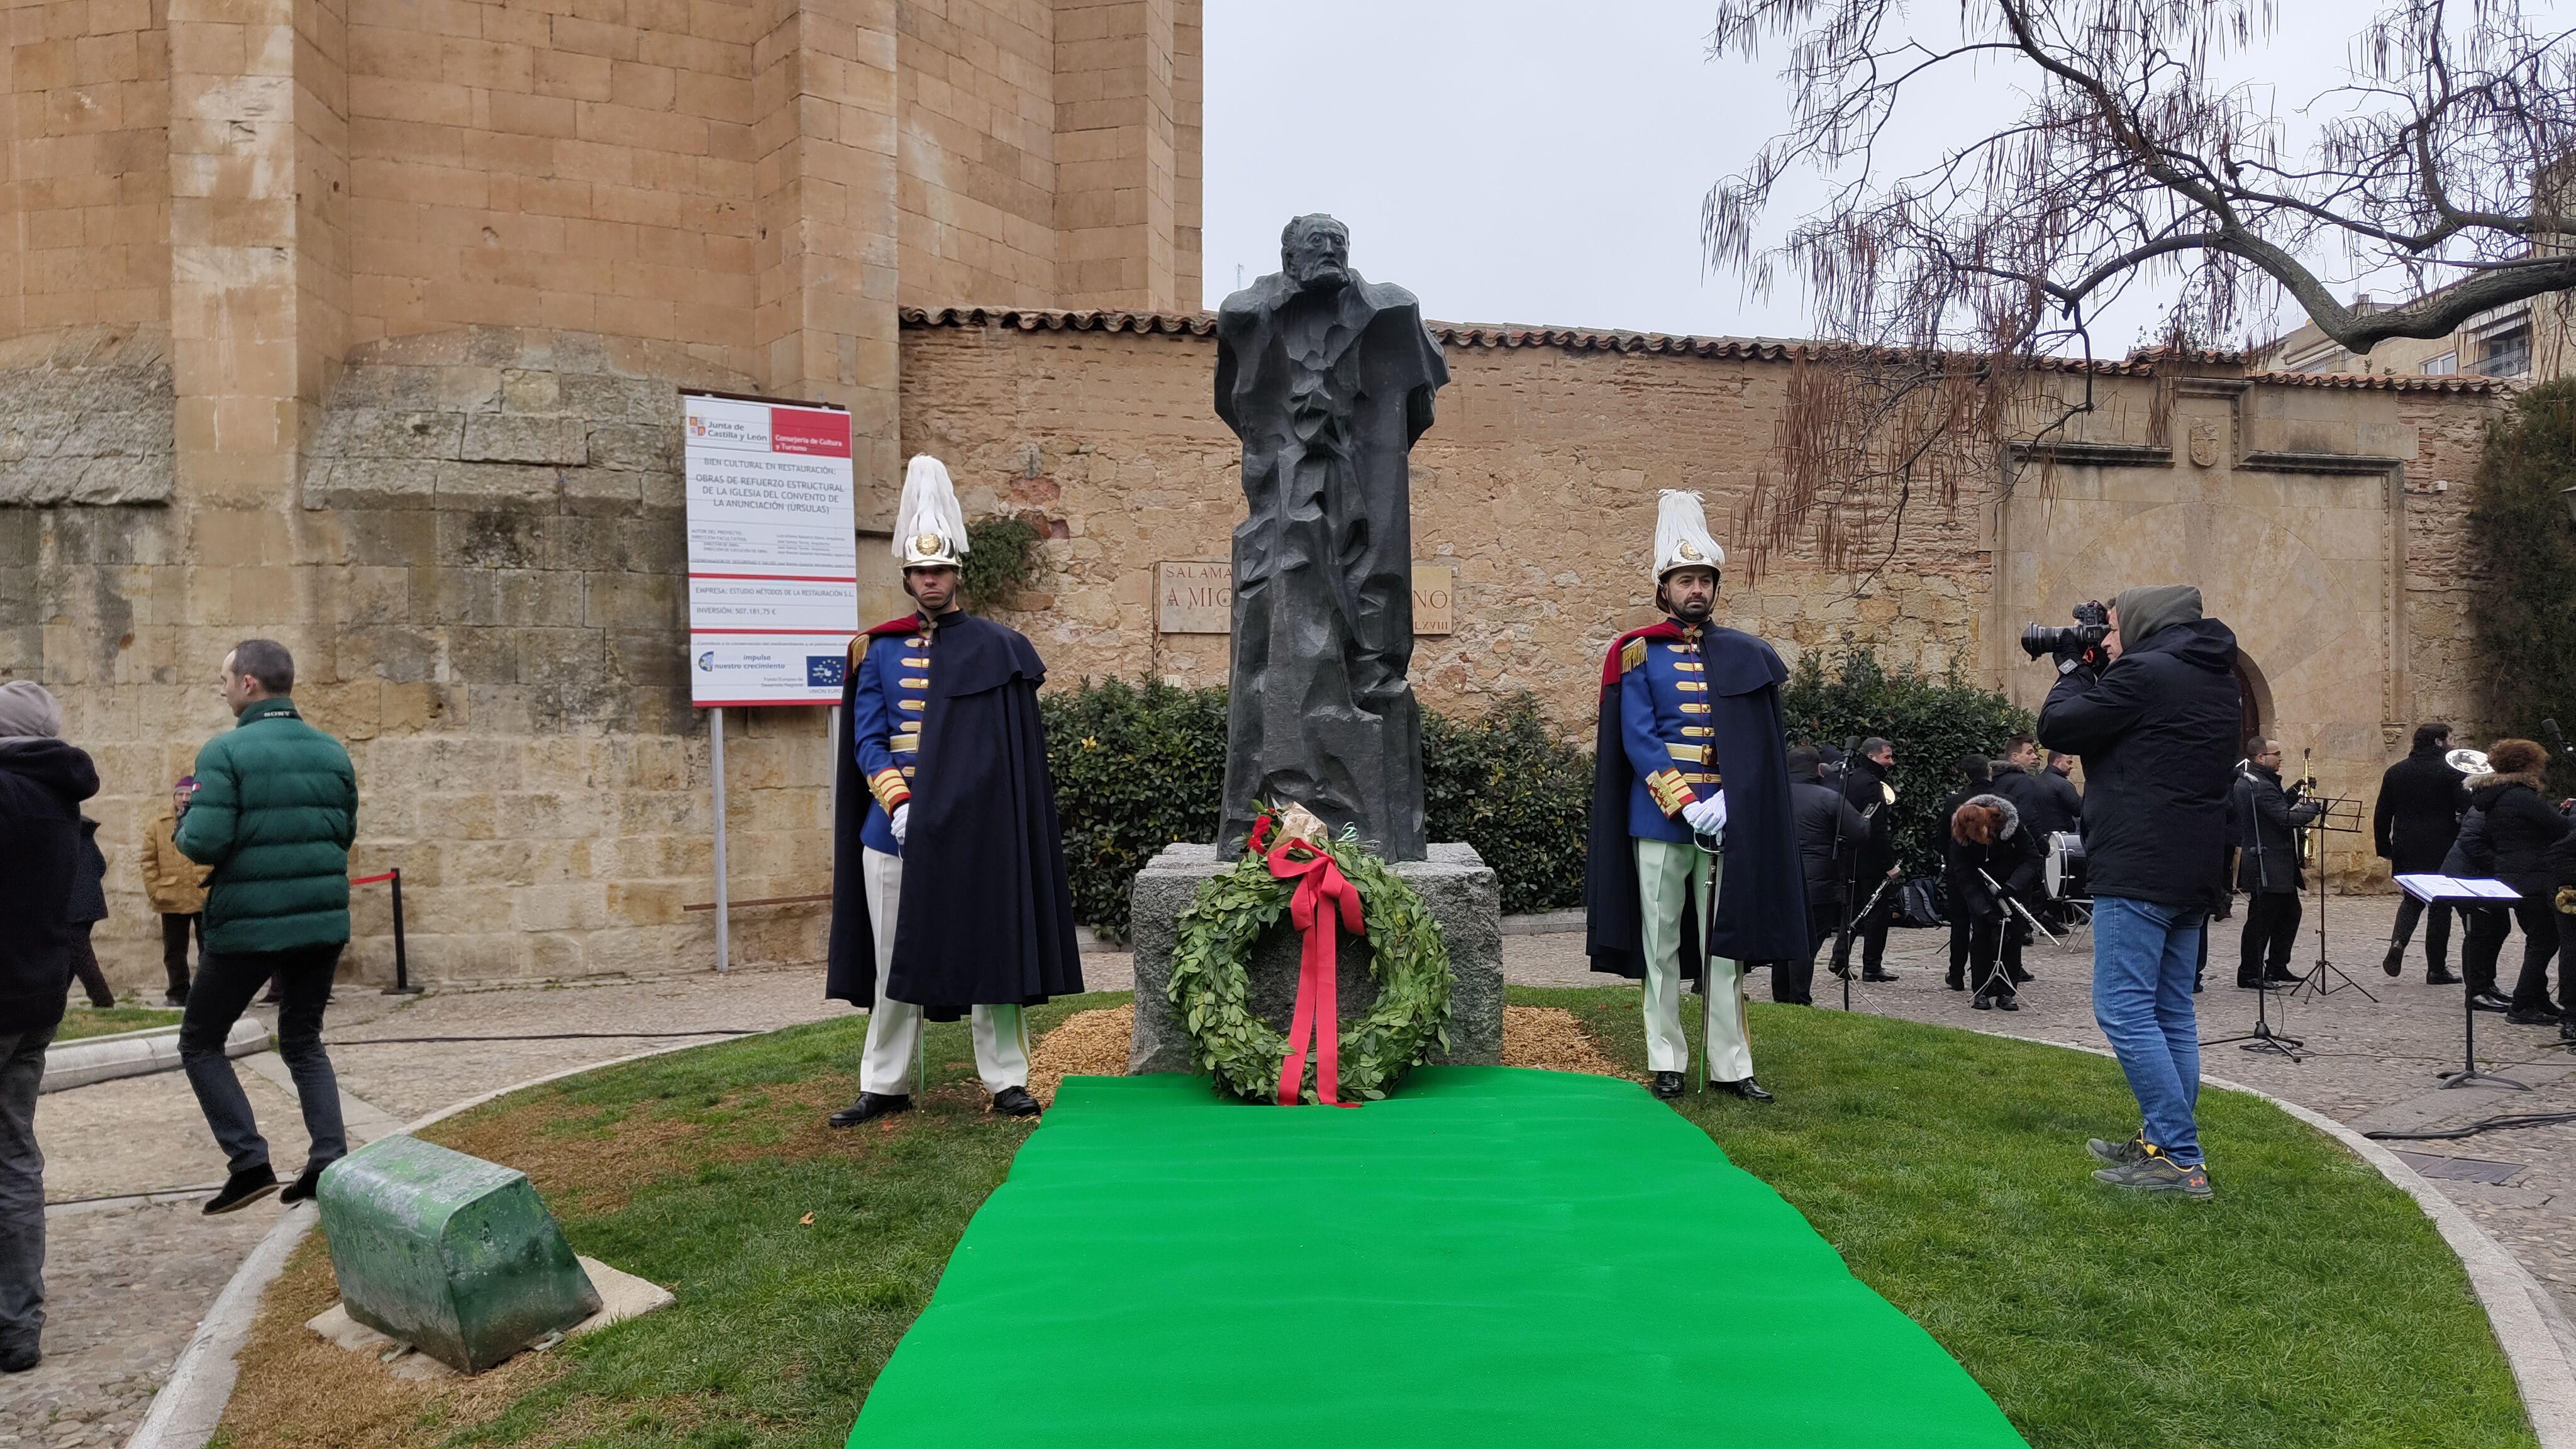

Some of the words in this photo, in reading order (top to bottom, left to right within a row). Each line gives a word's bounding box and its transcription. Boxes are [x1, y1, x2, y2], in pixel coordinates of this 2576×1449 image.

[708, 421, 733, 430] Junta
[708, 430, 738, 439] Castilla
[747, 433, 767, 441] León
[781, 443, 808, 452] Turismo
[819, 438, 843, 447] Cultura
[704, 458, 722, 466] BIEN
[724, 459, 763, 469] CULTURAL
[765, 462, 775, 470] EN
[696, 474, 724, 484] OBRAS
[727, 476, 738, 484] DE
[741, 477, 784, 488] REFUERZO
[787, 480, 845, 492] ESTRUCTURAL
[702, 486, 714, 495] DE
[716, 487, 728, 496] LA
[730, 488, 762, 497] IGLESIA
[763, 490, 779, 499] DEL
[781, 491, 826, 502] CONVENTO
[828, 494, 839, 503] DE
[713, 499, 726, 507] LA
[726, 499, 784, 511] ANUNCIACIÓN
[787, 502, 830, 514] (ÚRSULAS)
[1166, 565, 1232, 579] SALAMA
[696, 587, 728, 595] EMPRESA:
[756, 587, 783, 596] MÉTODOS
[802, 589, 843, 597] RESTAURACIÓN
[1166, 587, 1179, 607] A
[1188, 587, 1232, 608] MIG
[1413, 589, 1448, 609] NO
[735, 608, 770, 616] 507.181,75
[1414, 621, 1448, 630] LXVIII
